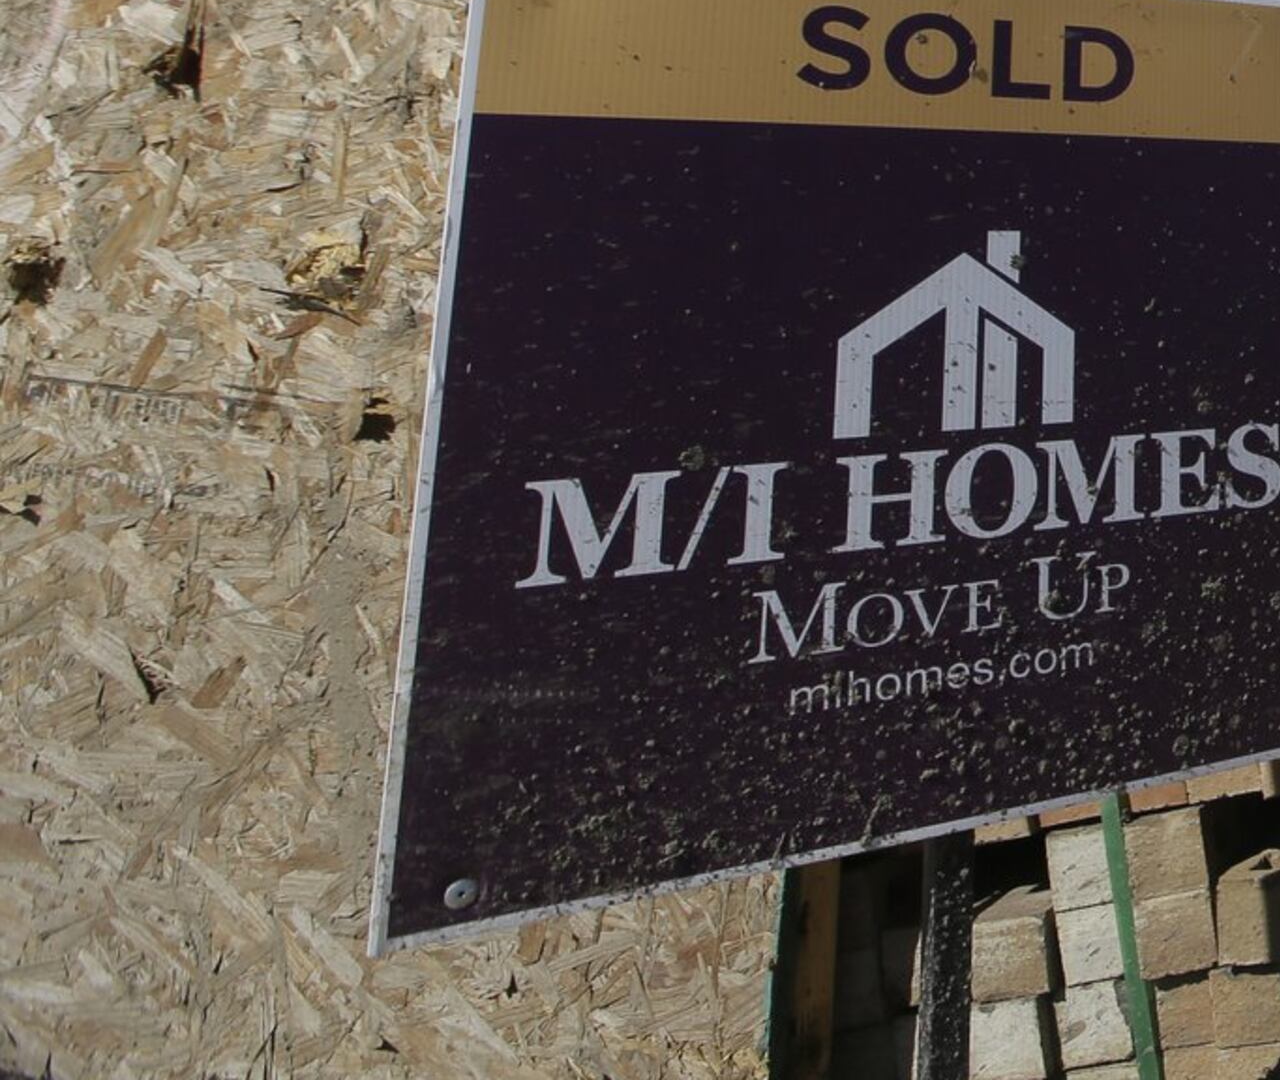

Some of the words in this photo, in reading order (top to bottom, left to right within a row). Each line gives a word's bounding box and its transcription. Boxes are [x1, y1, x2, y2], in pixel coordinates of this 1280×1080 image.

[797, 4, 1135, 104] SOLD
[514, 462, 789, 589] M/I
[788, 638, 1096, 714] mihomes.com
